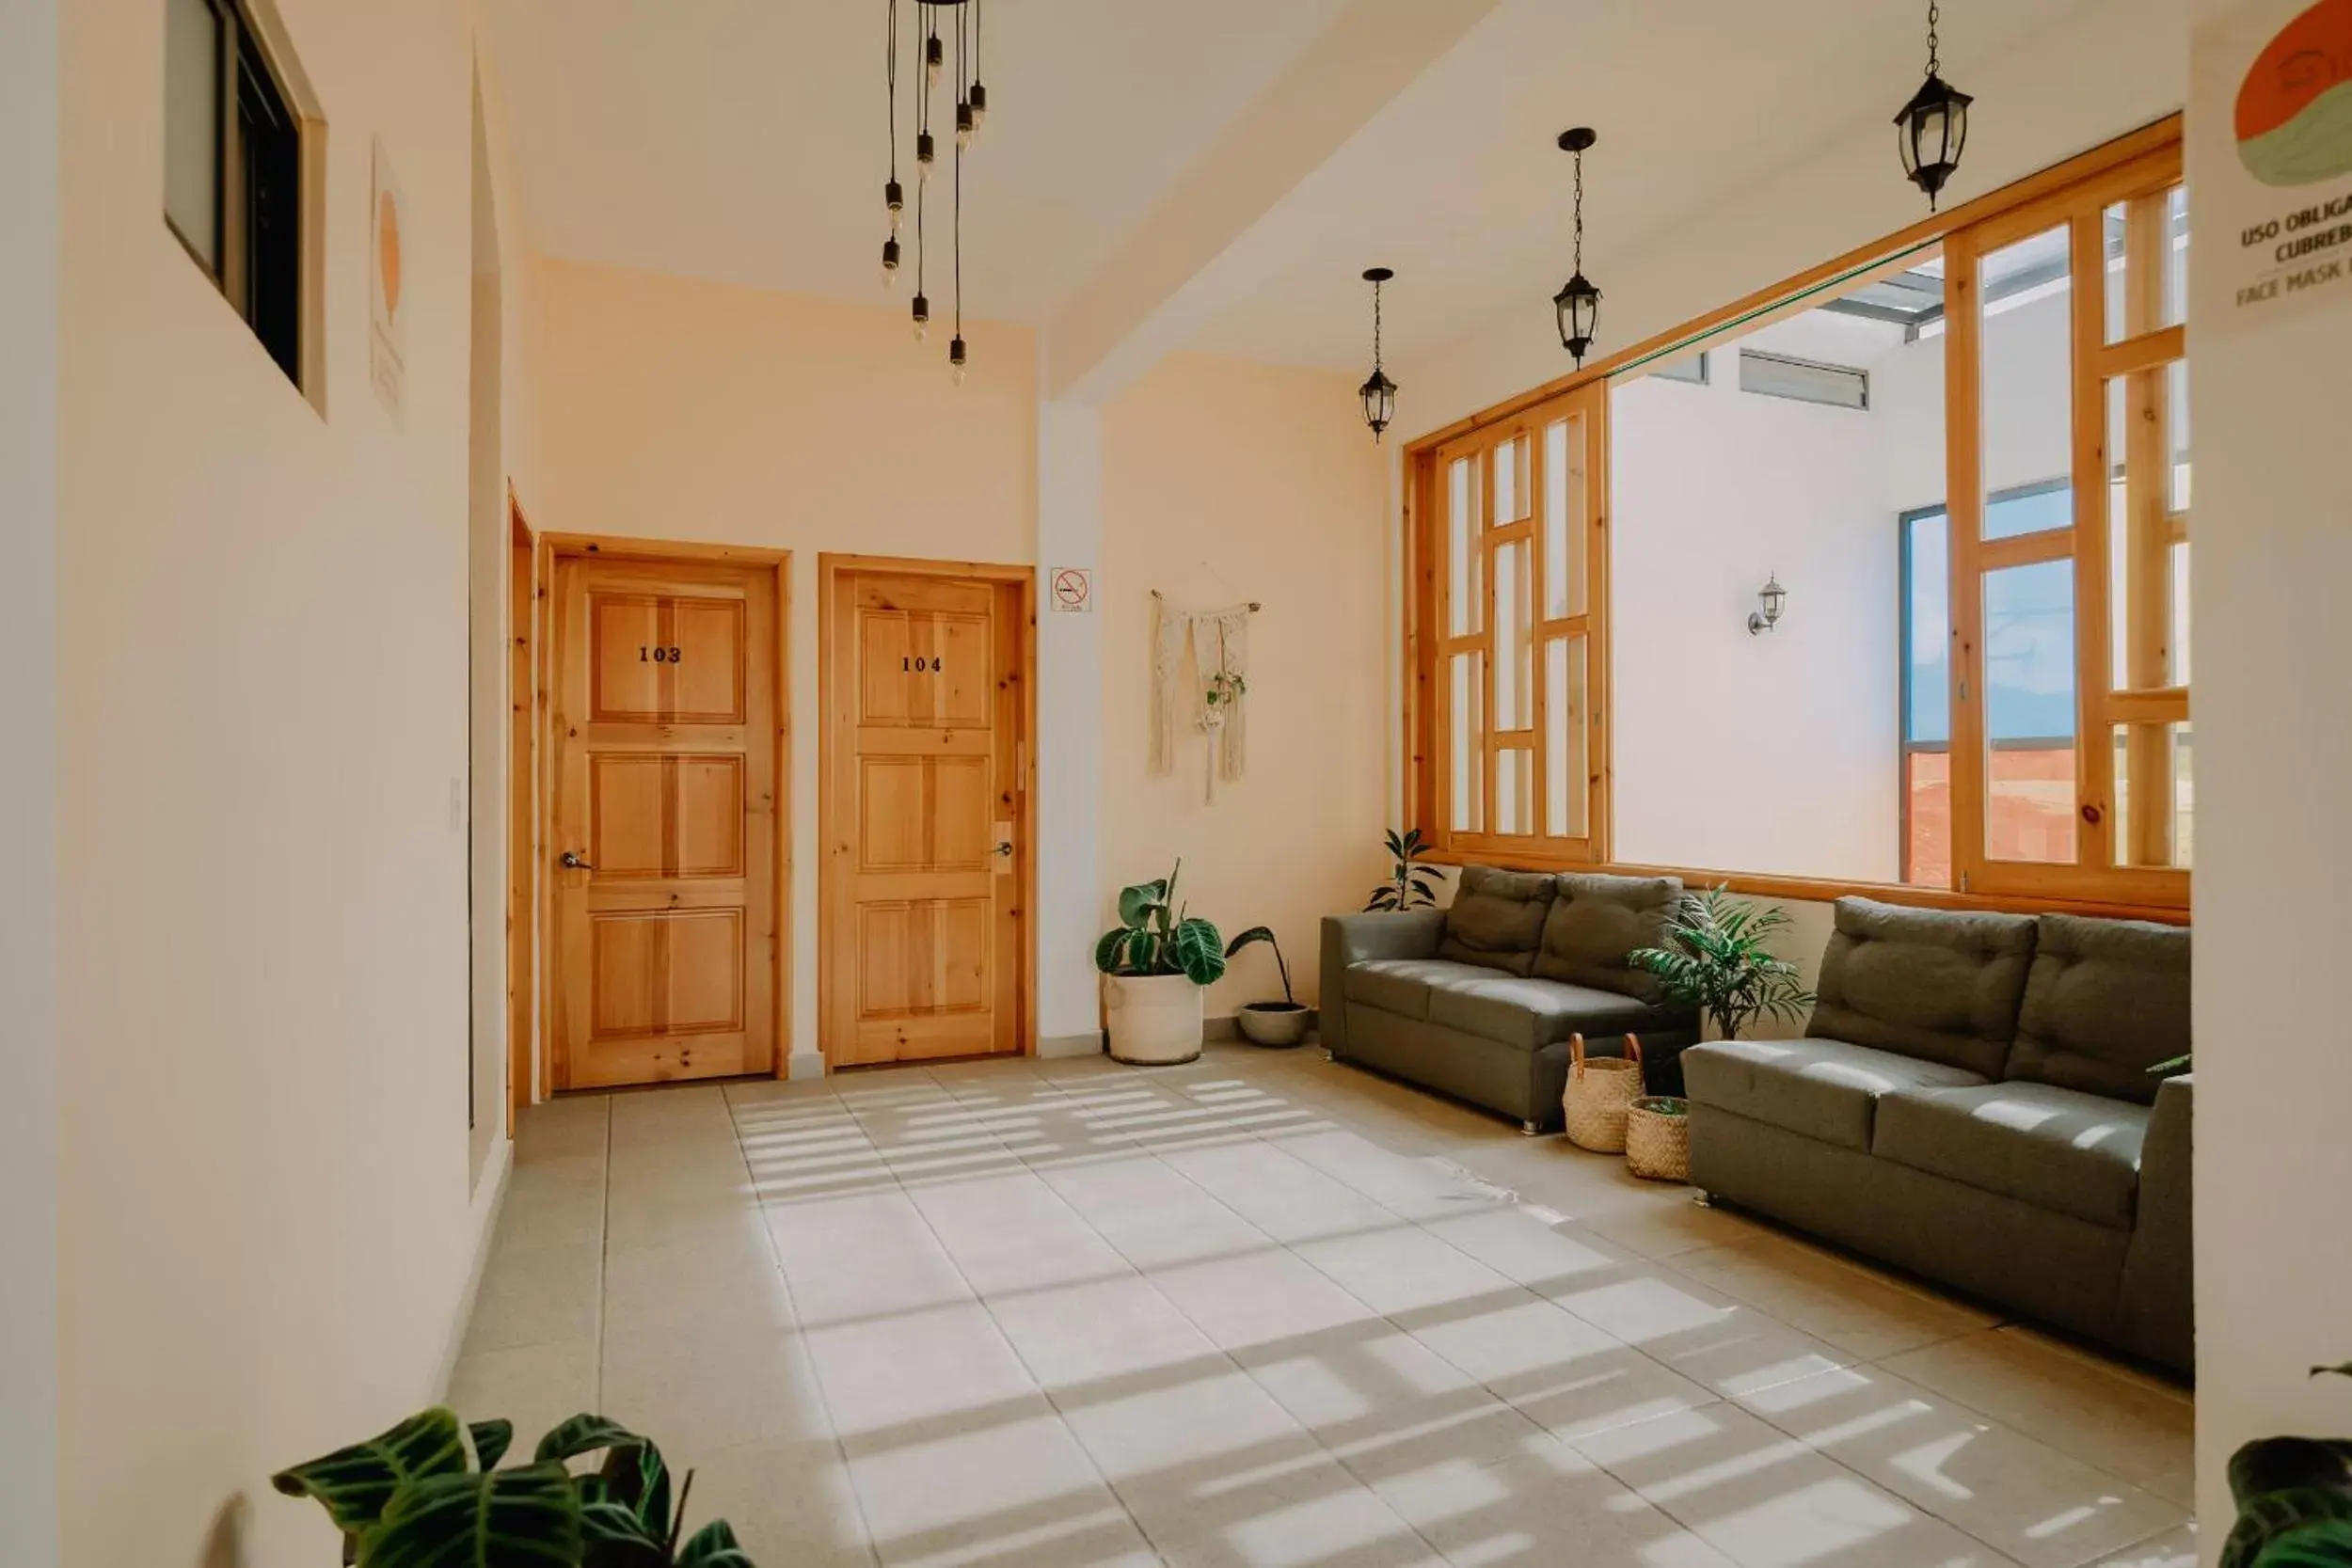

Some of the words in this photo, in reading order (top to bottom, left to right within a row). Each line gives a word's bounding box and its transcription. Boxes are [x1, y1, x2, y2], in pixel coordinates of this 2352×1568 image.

[2241, 220, 2279, 247] USO
[2276, 224, 2352, 262] CUBREB
[2236, 278, 2279, 307] FACE
[2286, 261, 2341, 293] MASK
[640, 646, 681, 663] 103
[902, 657, 941, 672] 104
